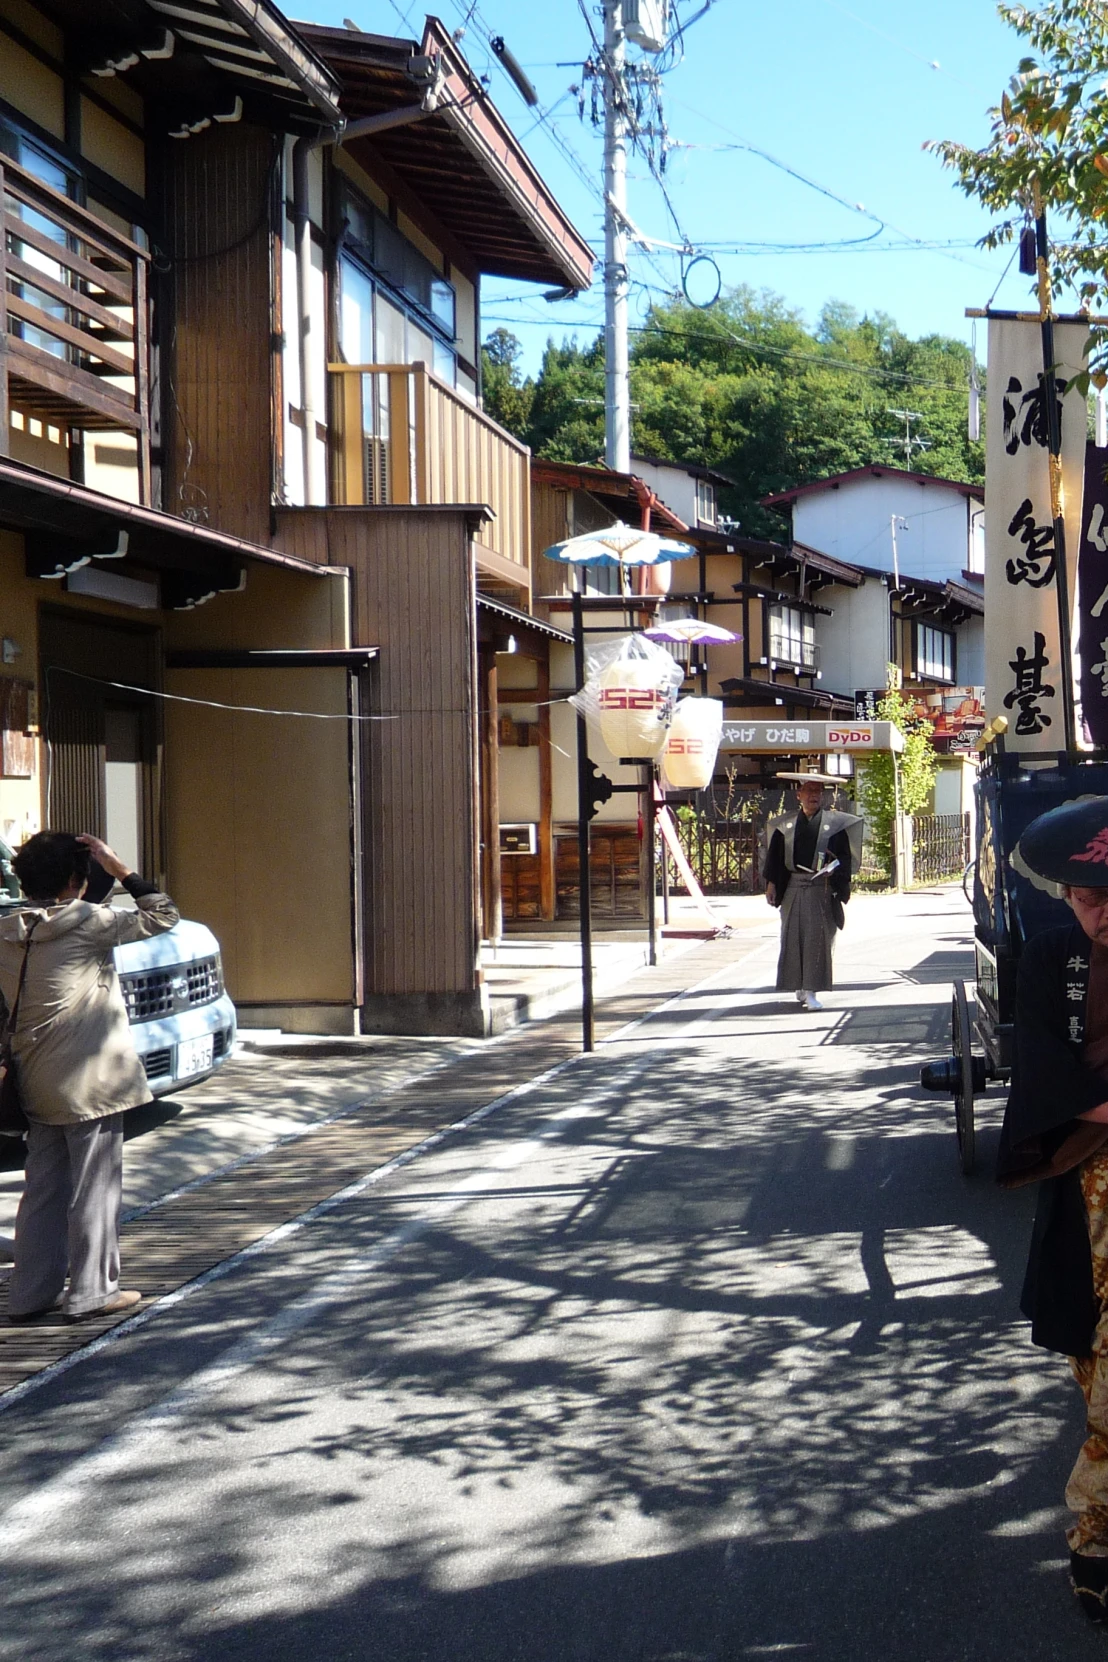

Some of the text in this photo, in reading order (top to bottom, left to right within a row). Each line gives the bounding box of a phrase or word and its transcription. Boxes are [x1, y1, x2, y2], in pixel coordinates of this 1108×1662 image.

[721, 728, 810, 743] やげ ひだ駒
[828, 731, 872, 745] DyDo
